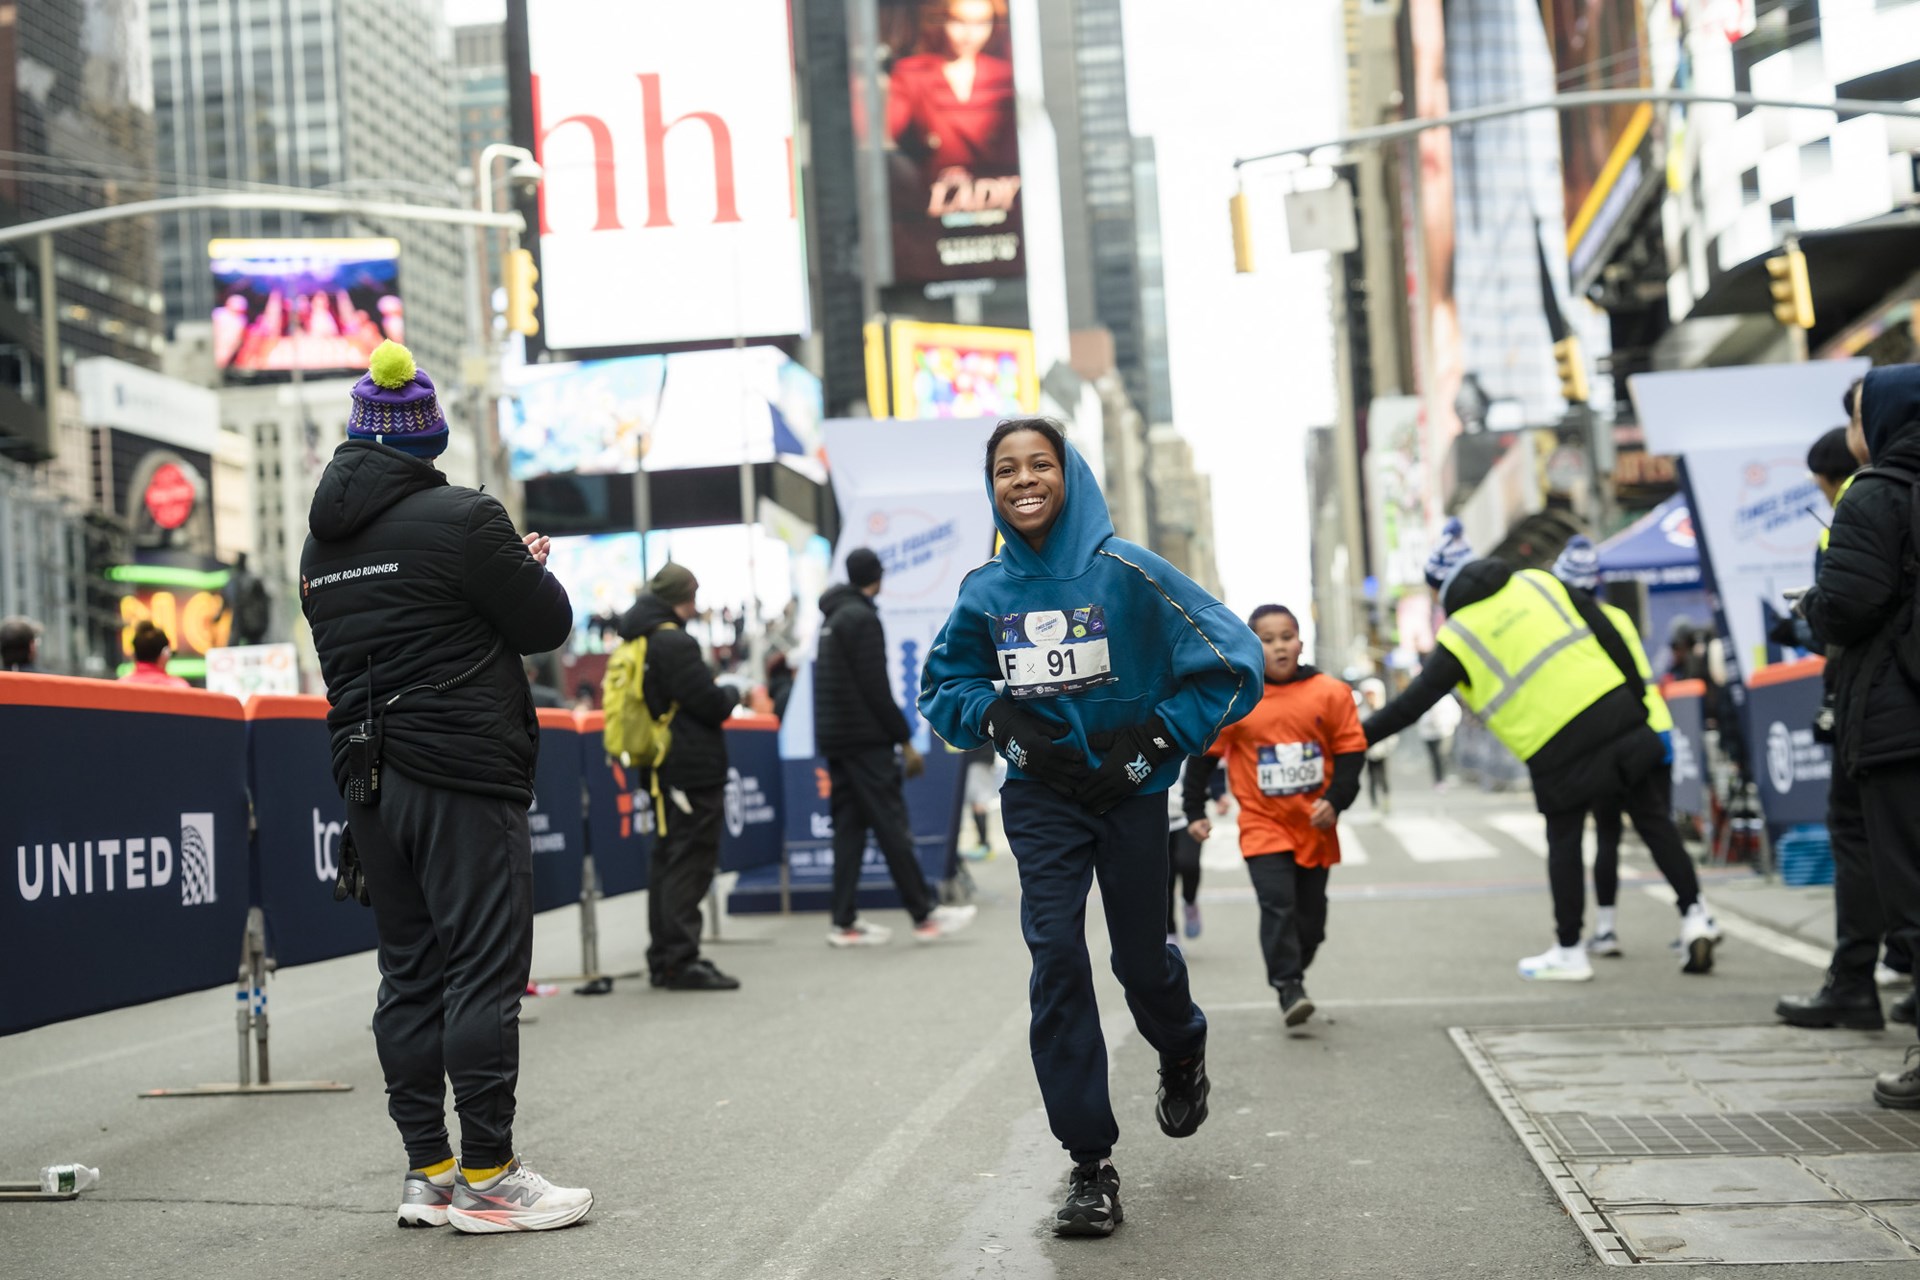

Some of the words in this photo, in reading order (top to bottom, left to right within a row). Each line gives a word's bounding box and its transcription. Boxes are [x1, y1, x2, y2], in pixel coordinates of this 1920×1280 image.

[310, 577, 324, 589] NEW
[323, 571, 342, 585] YORK
[342, 567, 361, 580] ROAD
[362, 562, 399, 576] RUNNERS
[1004, 654, 1017, 680] F
[1046, 648, 1077, 677] 91
[1128, 753, 1152, 780] 5K
[1261, 769, 1273, 785] H
[1280, 763, 1317, 783] 1909
[17, 836, 173, 901] UNITED
